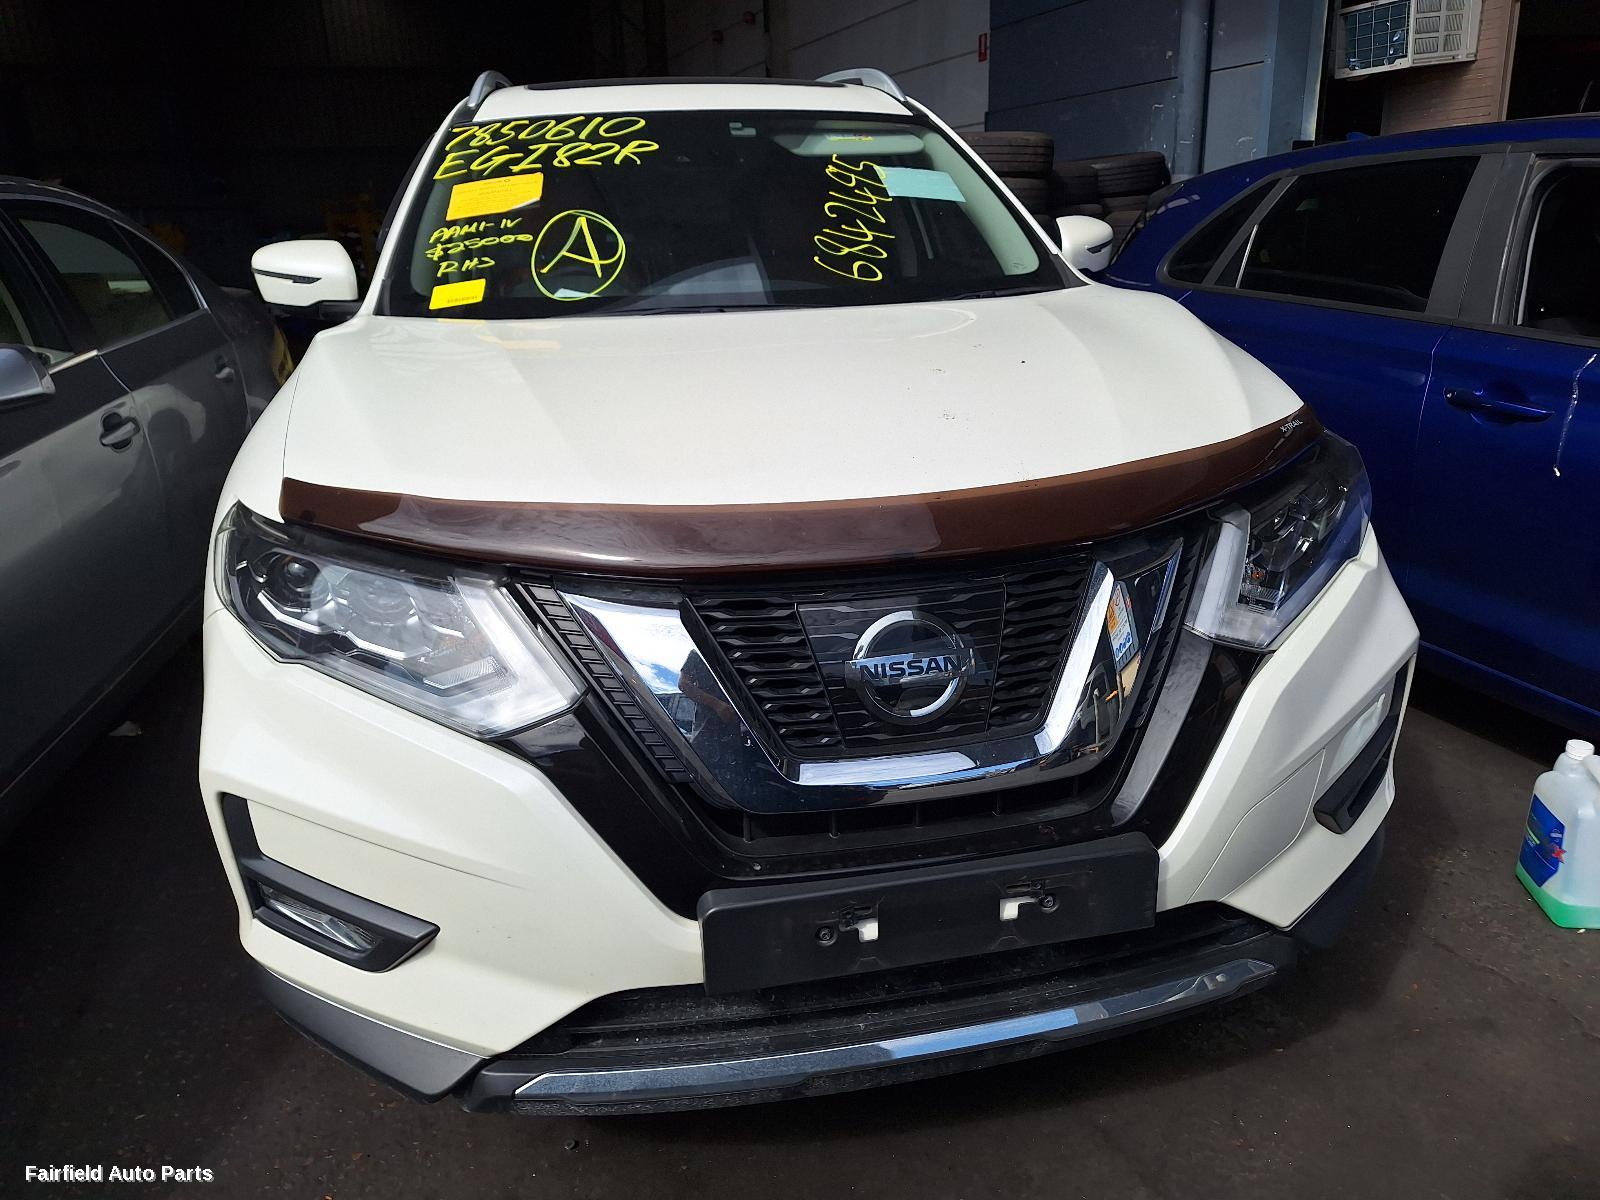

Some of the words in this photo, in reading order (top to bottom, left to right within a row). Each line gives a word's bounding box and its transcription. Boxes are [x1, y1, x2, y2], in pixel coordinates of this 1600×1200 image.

[445, 116, 646, 151] 7850610
[813, 153, 896, 282] 6842495
[540, 216, 612, 279] A
[1280, 419, 1303, 433] X-TRAIL
[859, 653, 965, 680] NISSAN
